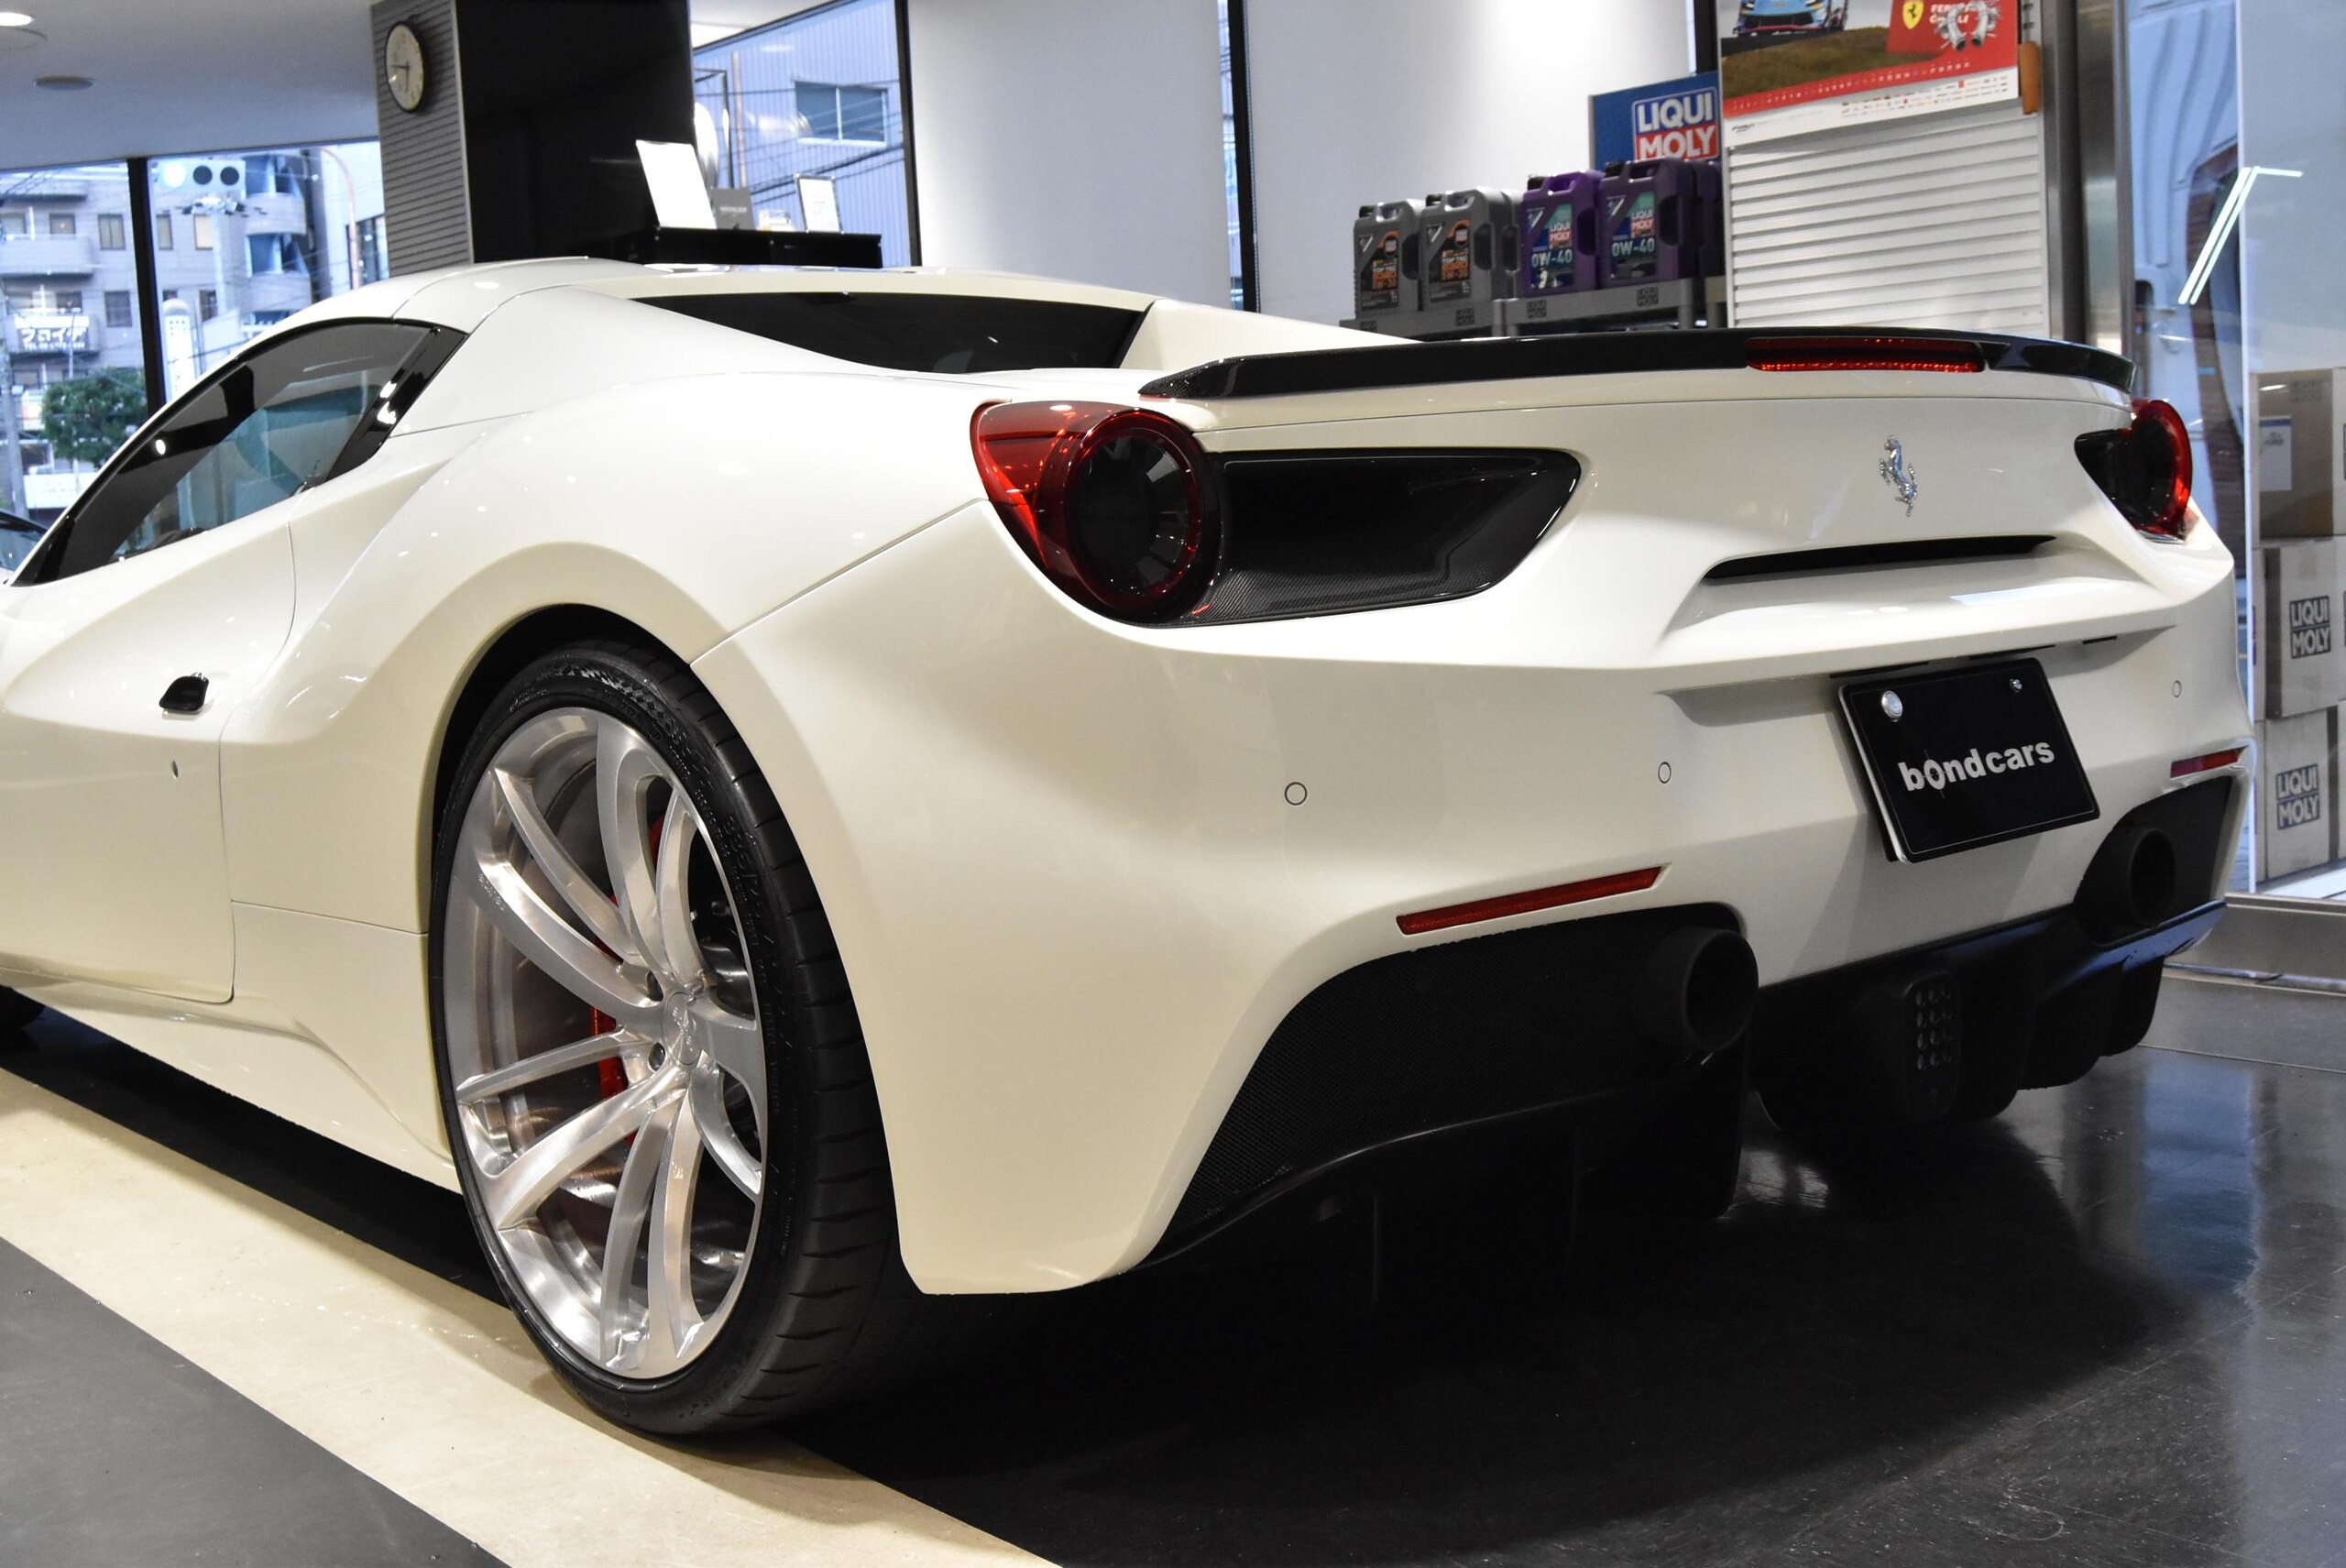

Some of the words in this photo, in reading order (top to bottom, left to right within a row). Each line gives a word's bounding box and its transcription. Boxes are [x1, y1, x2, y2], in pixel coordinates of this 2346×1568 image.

[1638, 93, 1713, 132] LIQUI
[1639, 126, 1716, 159] MOLY
[1531, 249, 1573, 268] 0W-40
[1612, 238, 1655, 257] 0W-40
[2292, 598, 2329, 627] LIQUI
[2293, 627, 2330, 657] MOLY
[2277, 766, 2318, 798] LIQUI
[2278, 795, 2319, 828] MOLY
